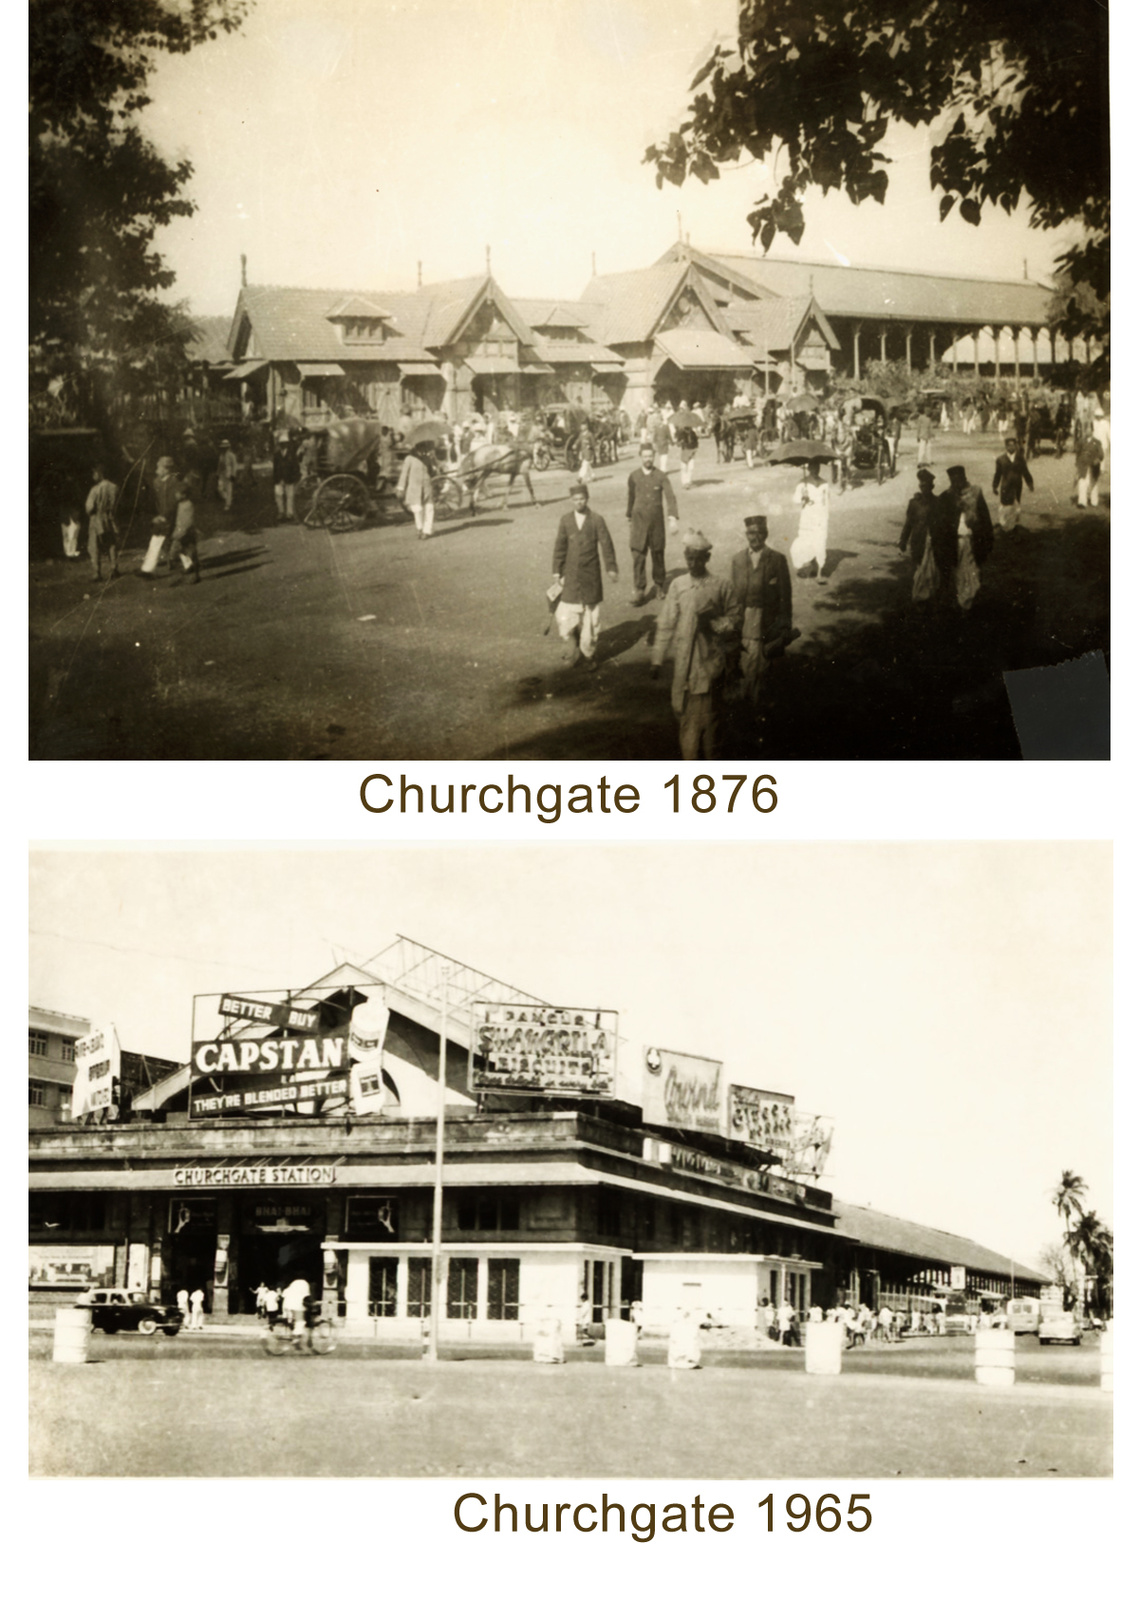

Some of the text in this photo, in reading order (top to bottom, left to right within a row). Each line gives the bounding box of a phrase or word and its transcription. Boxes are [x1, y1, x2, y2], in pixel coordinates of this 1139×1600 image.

[222, 998, 317, 1028] BETTER BUY
[195, 1038, 344, 1073] CAPSTAN
[194, 1080, 348, 1113] THEY'RE BLENDED BETTER
[174, 1166, 335, 1185] CHURCHGATE STATION
